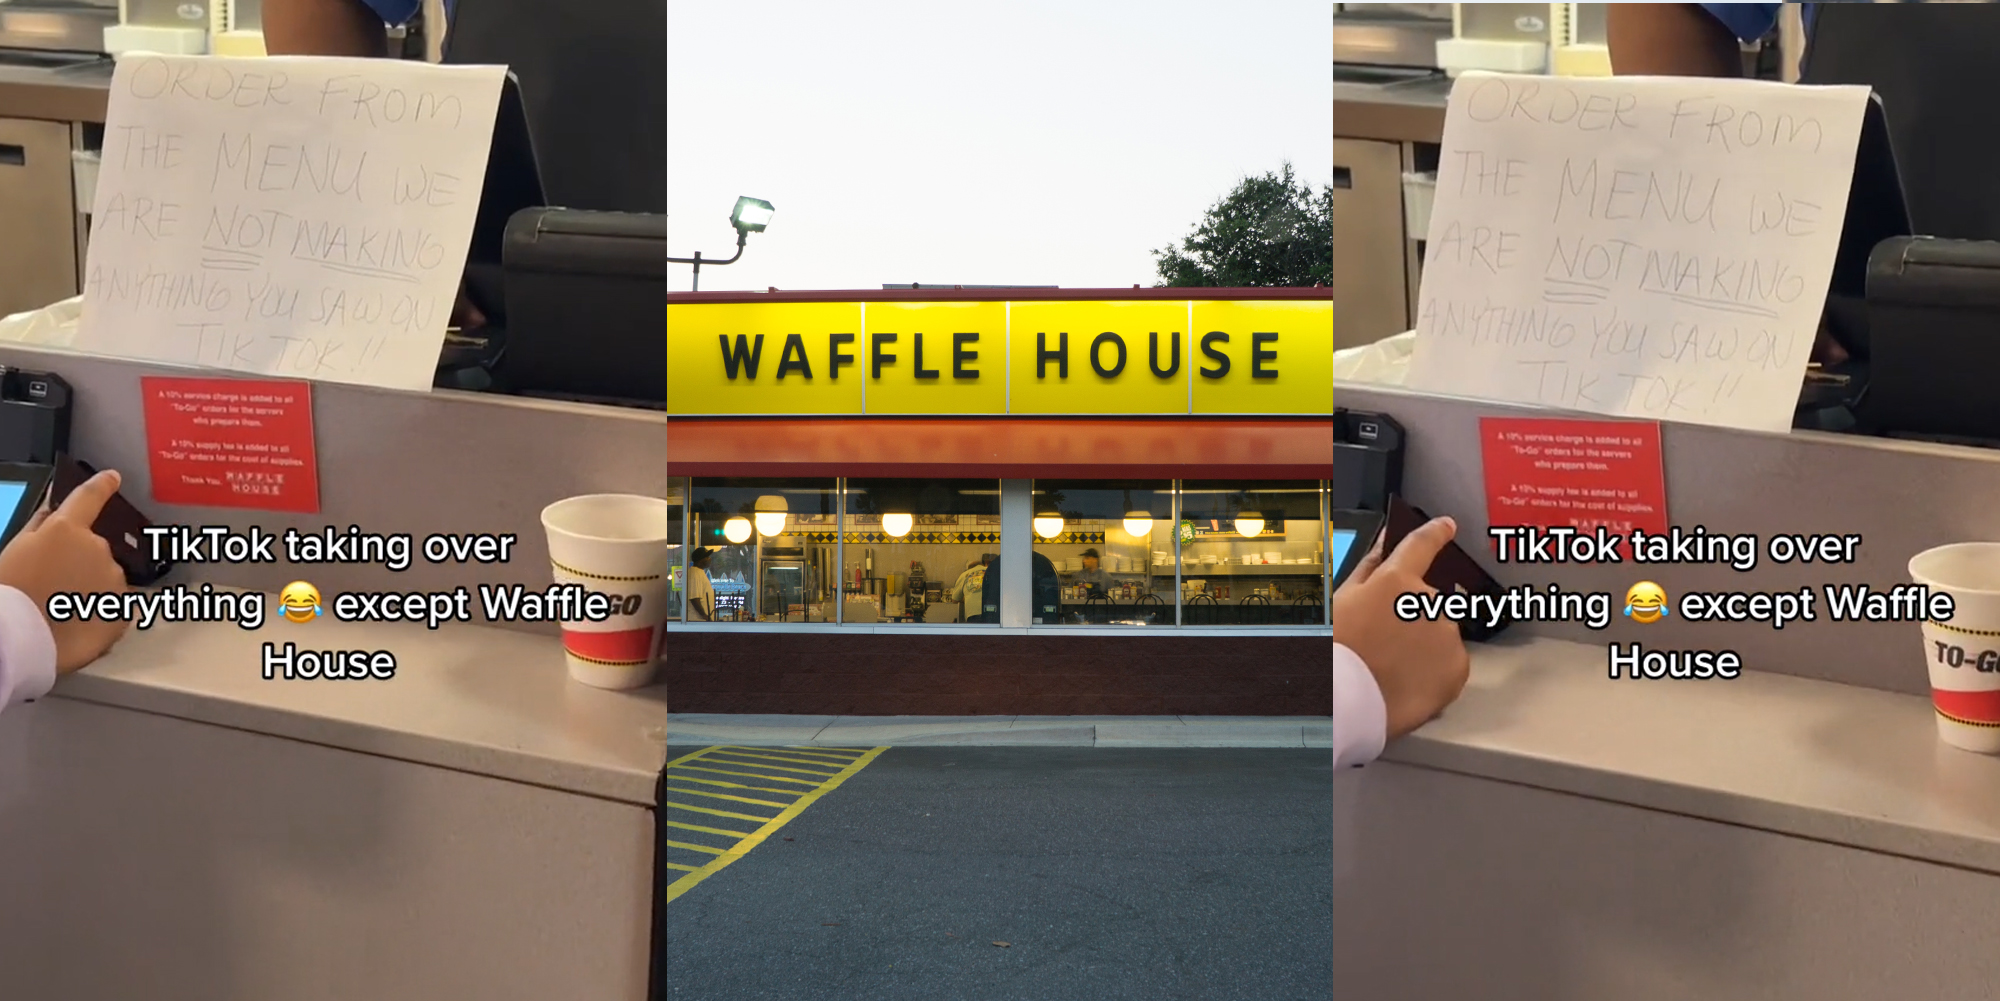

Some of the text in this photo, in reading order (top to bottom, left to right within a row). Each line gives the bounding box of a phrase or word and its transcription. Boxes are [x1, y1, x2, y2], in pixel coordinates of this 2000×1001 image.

[130, 58, 462, 129] ORDER FROM
[1468, 79, 1822, 154] ORDER FROM
[117, 125, 461, 207] THE MENU WE
[1454, 150, 1822, 237] THE MENU WE
[99, 193, 445, 270] ARE NOT MAKING
[1433, 221, 1804, 303] ARE NOT MAKING
[88, 264, 435, 333] ANYTHING YOU SAW ON
[176, 323, 254, 367] TIK
[719, 331, 1279, 380] WAFFLE HOUSE
[1422, 295, 1795, 370] ANYTHING YOU SAW ON
[158, 390, 164, 398] A
[1517, 360, 1599, 407] TIK
[1498, 432, 1504, 440] A
[225, 471, 285, 484] WAFFLE
[232, 483, 281, 495] HOUSE
[1934, 640, 2000, 673] TO-G
